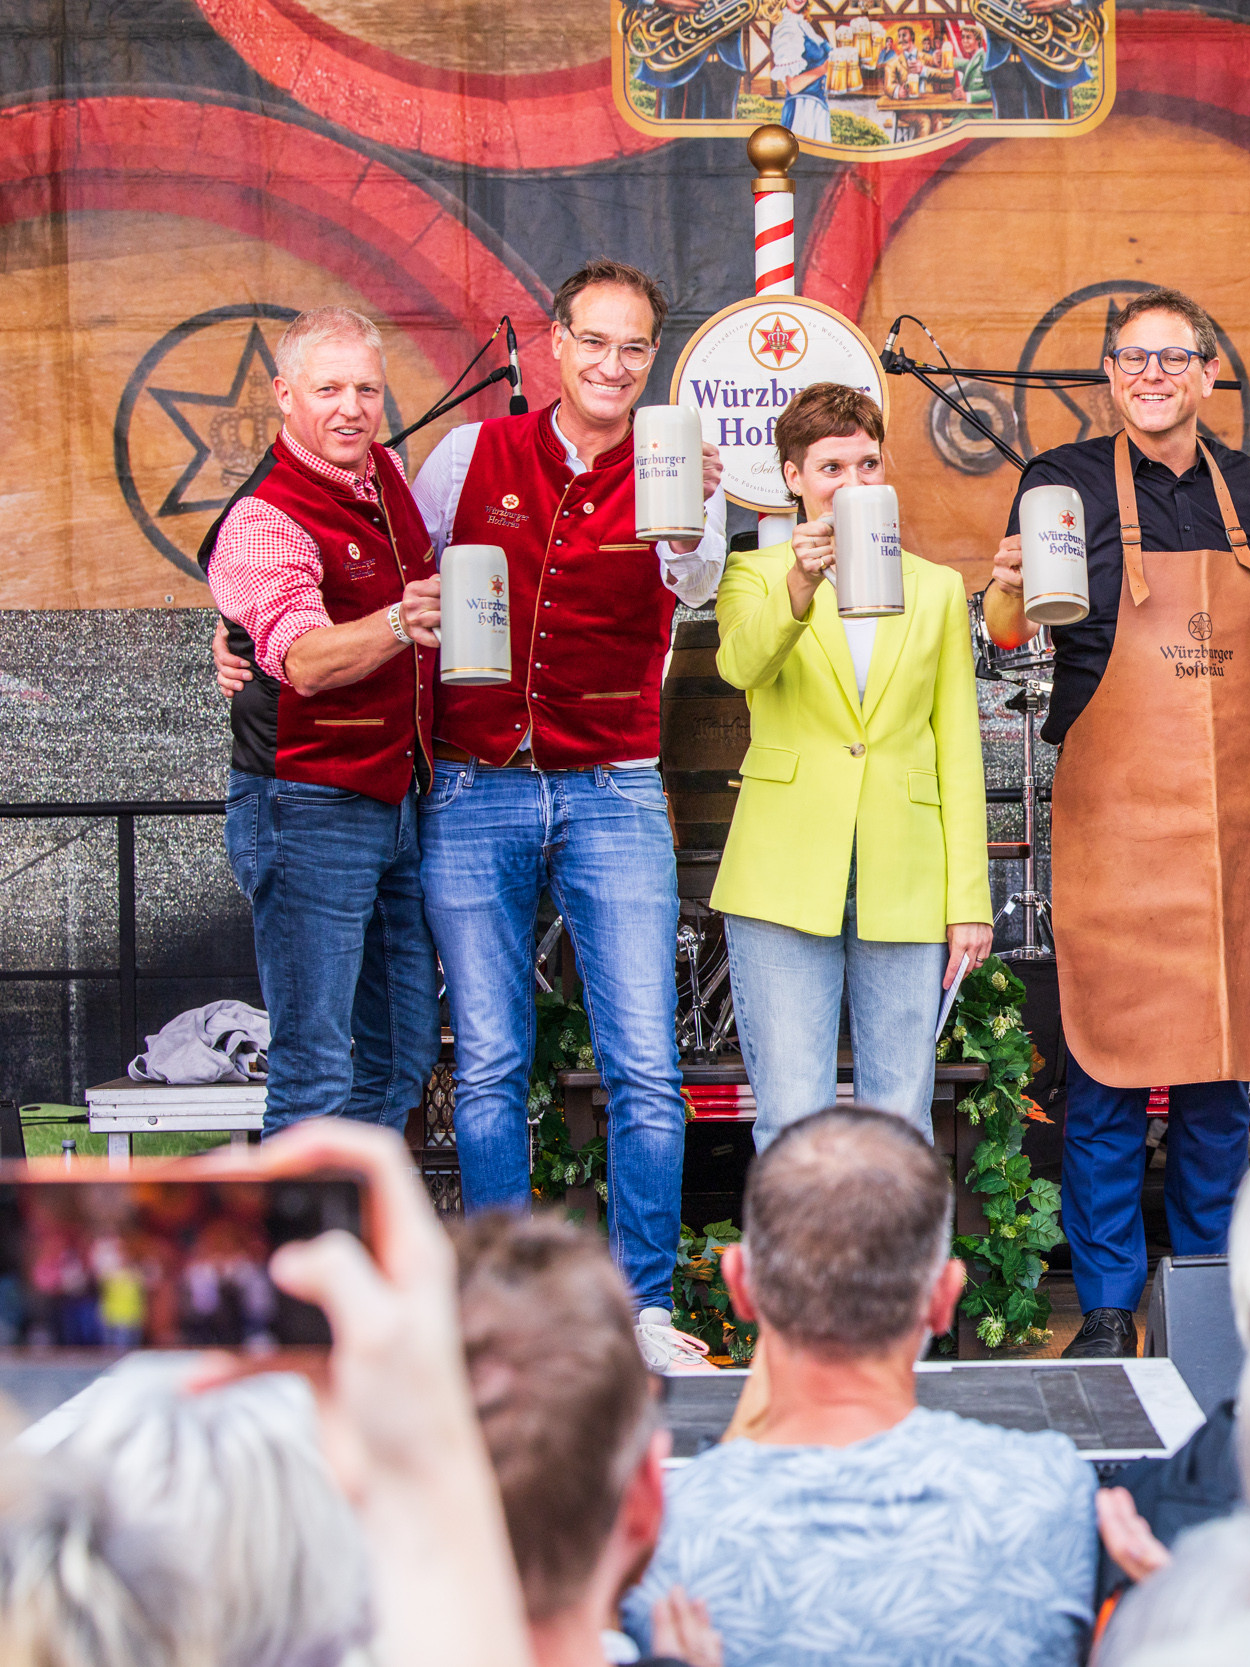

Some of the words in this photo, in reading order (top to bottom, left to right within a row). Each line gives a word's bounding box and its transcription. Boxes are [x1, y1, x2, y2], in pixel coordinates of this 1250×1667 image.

[690, 378, 871, 408] Würzbr
[639, 466, 679, 480] Hofbräu
[1038, 530, 1086, 550] Würzburg
[1160, 644, 1234, 664] Würzburger
[1175, 660, 1225, 680] Hofbräu
